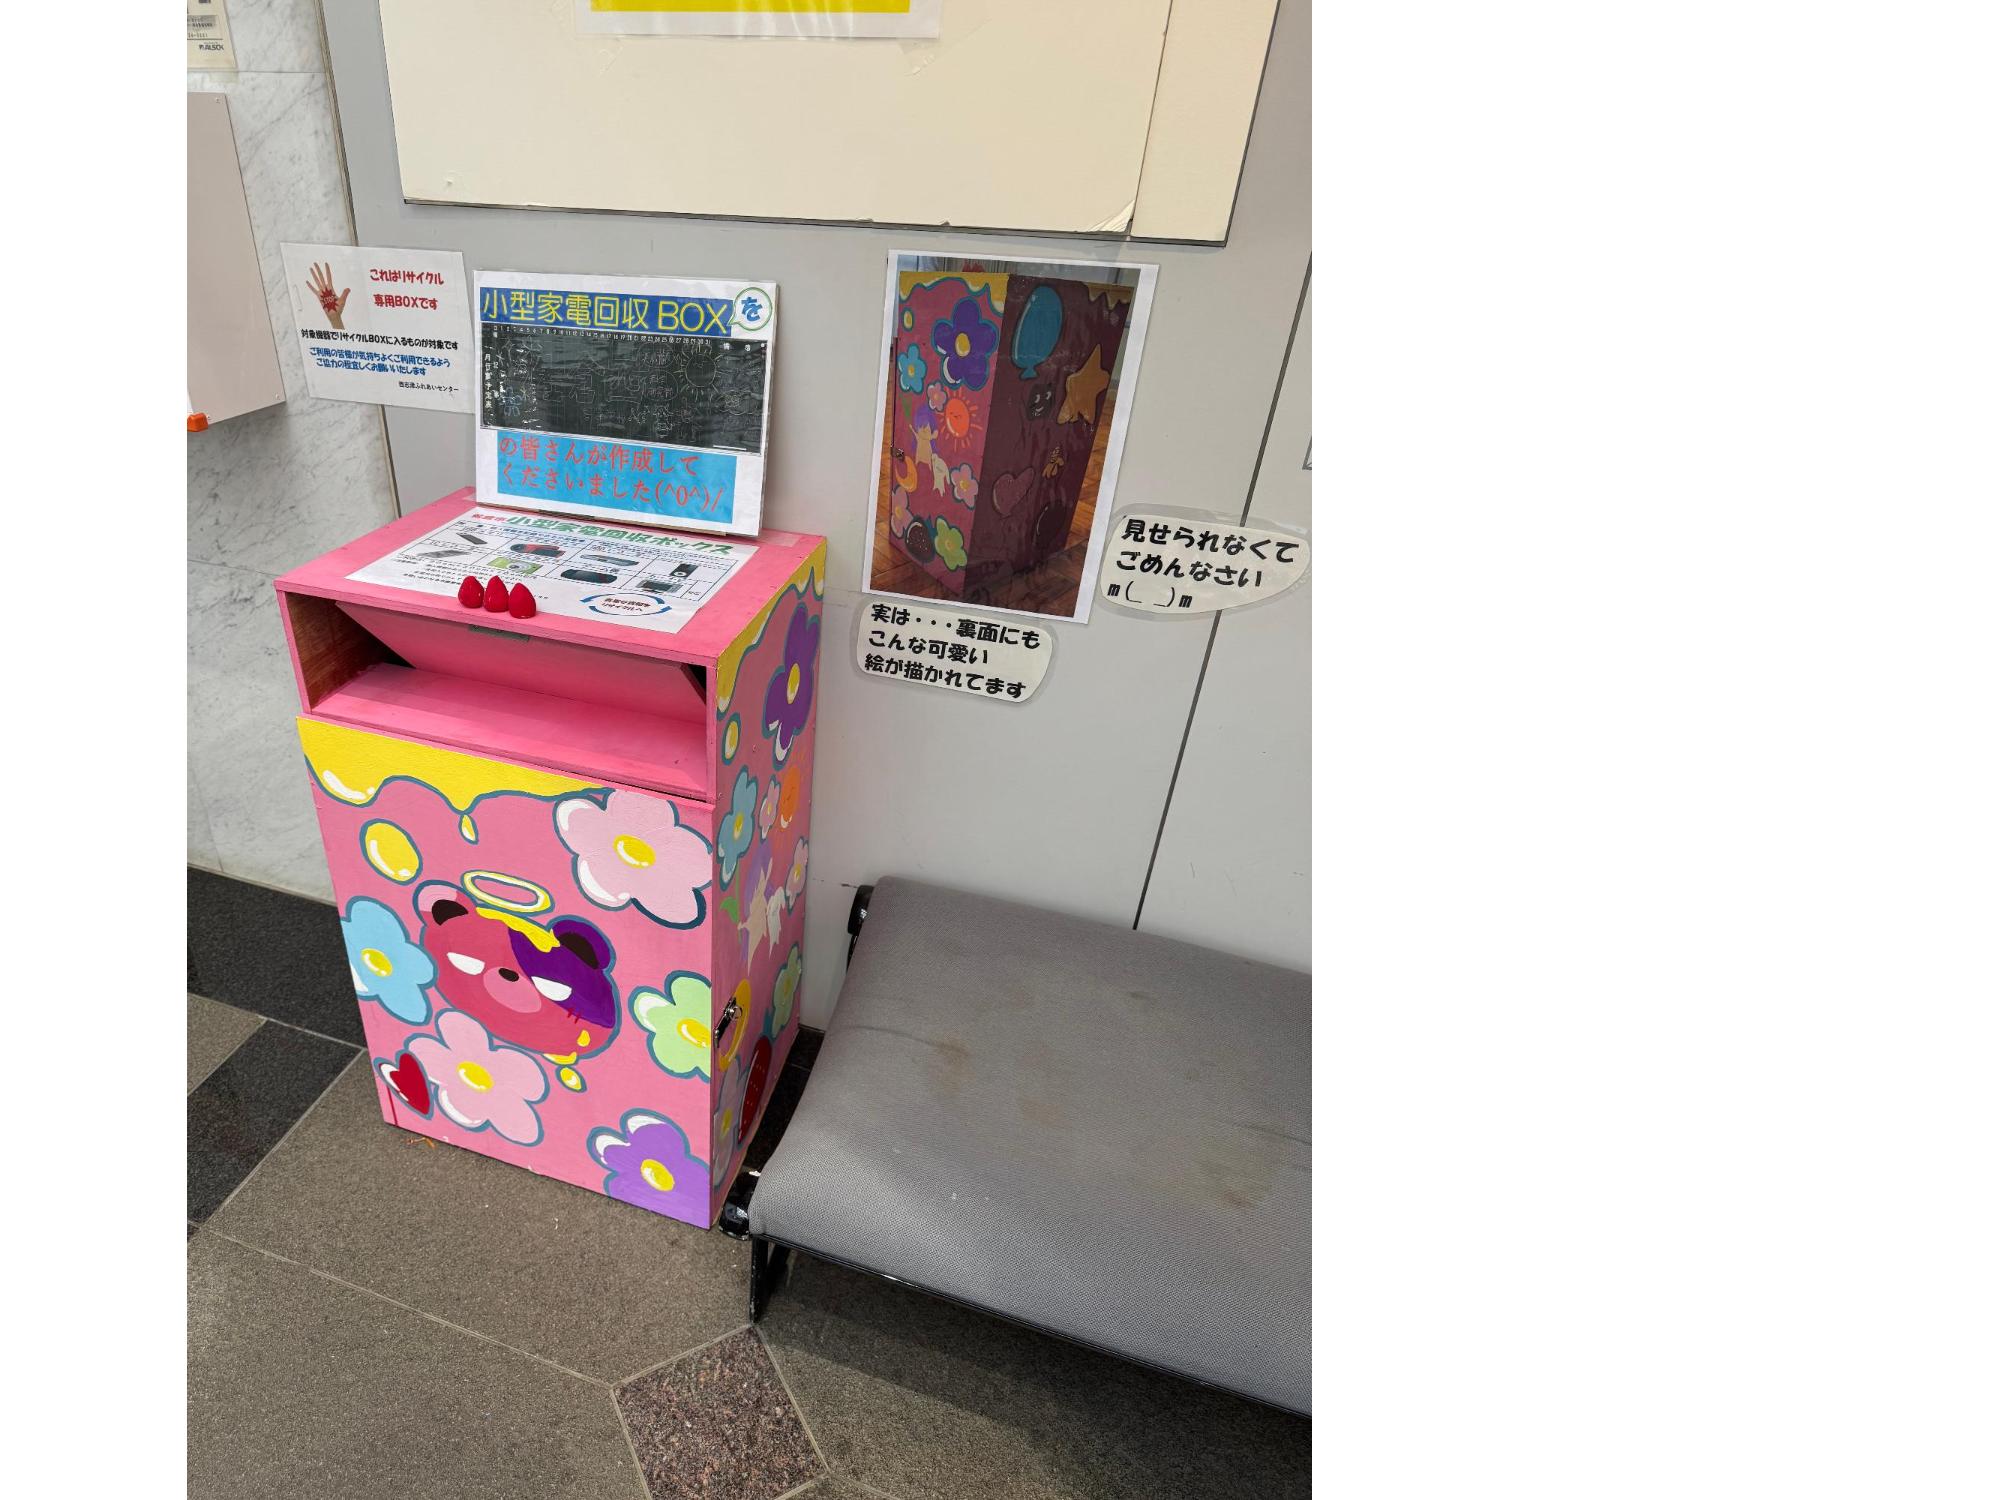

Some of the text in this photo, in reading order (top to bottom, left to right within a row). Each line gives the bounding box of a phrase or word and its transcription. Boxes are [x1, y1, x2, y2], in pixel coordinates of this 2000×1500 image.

[370, 268, 444, 285] これはリサイクル
[373, 293, 438, 310] 専用BOXです
[483, 288, 729, 335] 小型家電回収 BOX
[740, 295, 761, 322] を
[300, 328, 459, 351] 対象機器でリサイクルBOXに入るものが対象です
[499, 436, 700, 477] の皆さんが作成して
[507, 516, 733, 555] 小型家電回収ボックス
[1121, 518, 1300, 563] 見せられなくて
[1116, 551, 1262, 588] ごめんなさい
[870, 603, 1041, 650] 実は・・・裏面にも
[868, 630, 989, 664] こんな可愛い
[864, 653, 1027, 699] 絵が描かれてます
